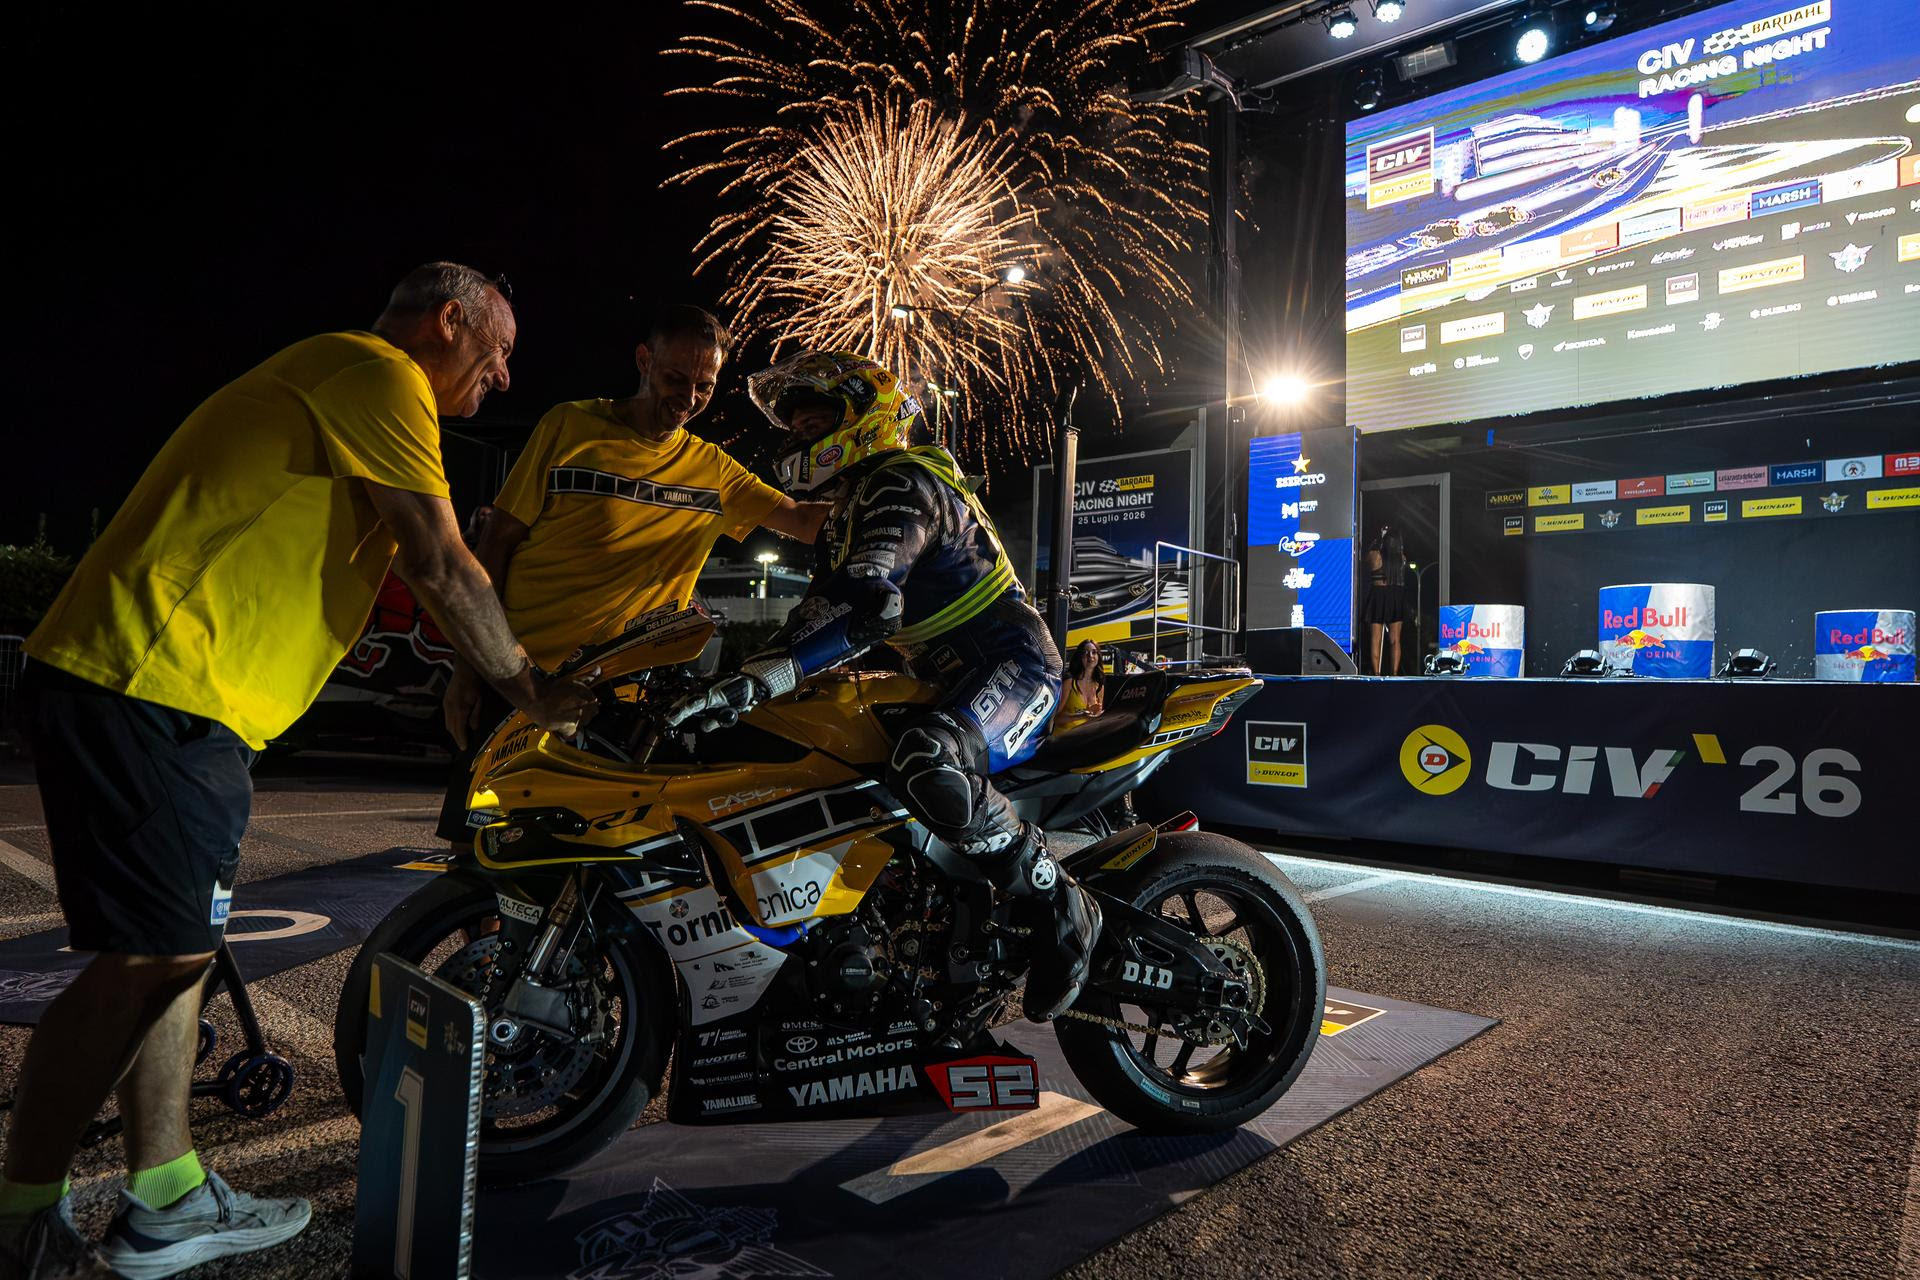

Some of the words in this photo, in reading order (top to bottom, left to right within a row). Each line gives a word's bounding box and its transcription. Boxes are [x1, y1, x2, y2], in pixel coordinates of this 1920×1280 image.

[1638, 38, 1695, 75] CIV
[1752, 4, 1825, 34] BARDAHL
[1638, 55, 1738, 99] RACING
[1743, 26, 1831, 69] NIGHT
[1375, 145, 1424, 172] CIV
[1758, 187, 1811, 209] MARSH
[1120, 475, 1153, 489] BARDAHL
[1275, 473, 1326, 489] ESERCITO
[1776, 468, 1816, 480] MARSH
[662, 490, 694, 504] YAMAHA
[1073, 497, 1114, 511] RACING
[1117, 492, 1154, 507] NIGHT
[1489, 493, 1524, 504] ARROW
[1648, 511, 1685, 519] DUNLOP
[1755, 503, 1795, 511] DUNLOP
[1078, 516, 1089, 525] 25
[1091, 514, 1119, 525] Luglio
[1123, 511, 1146, 521] 2026
[1603, 607, 1638, 629] Red
[1642, 607, 1687, 628] Bull
[1441, 622, 1465, 639] Red
[1468, 622, 1500, 639] Bull
[1830, 627, 1868, 645] Red
[1871, 628, 1905, 645] Bull
[1645, 651, 1681, 659] DRINK
[490, 735, 529, 766] YAMAHA
[1262, 769, 1299, 777] DUNLOP
[1120, 834, 1156, 863] DUNLOP
[499, 898, 541, 919] ALTECA
[410, 1000, 427, 1017] CIV
[774, 1049, 845, 1072] Central
[846, 1038, 914, 1061] Motors
[786, 1064, 918, 1108] YAMAHA
[948, 1064, 1036, 1109] 52
[702, 1094, 757, 1111] YAMALUBE
